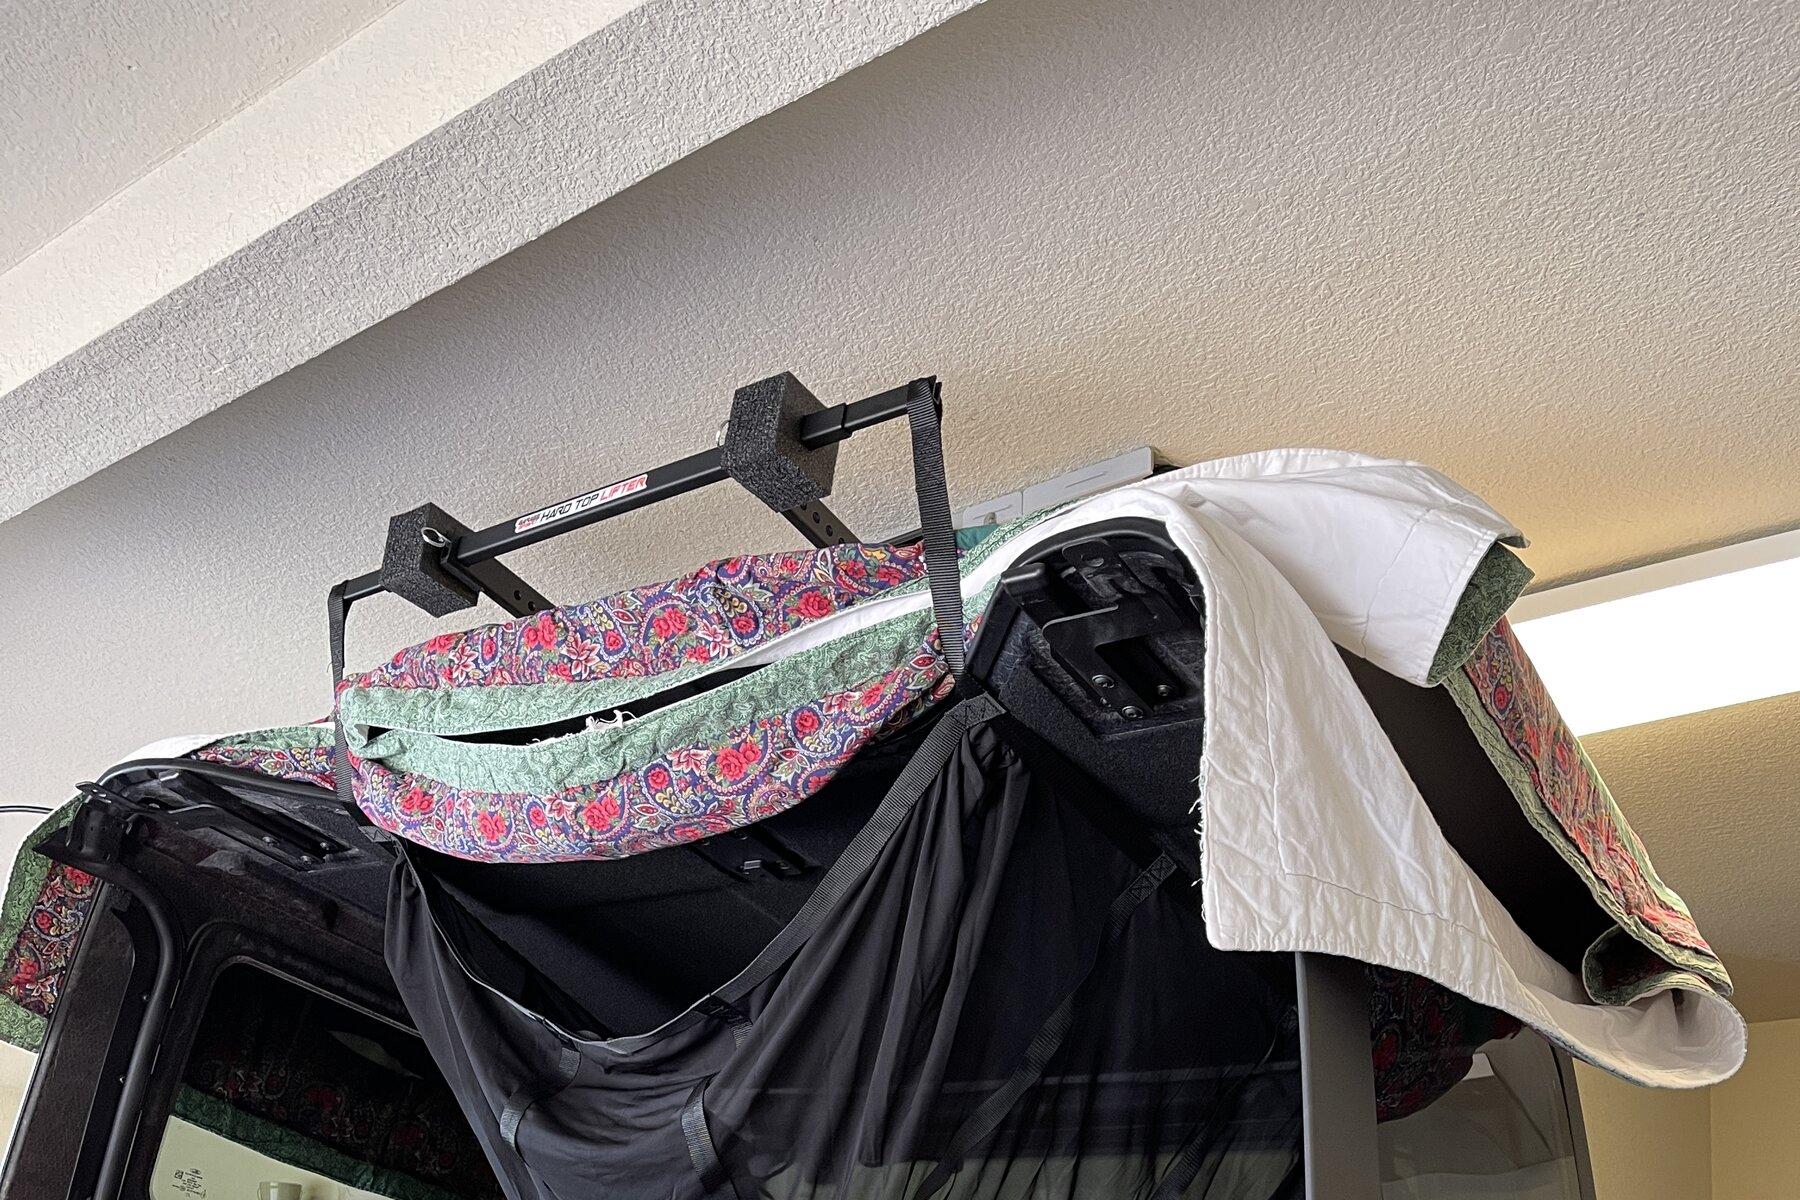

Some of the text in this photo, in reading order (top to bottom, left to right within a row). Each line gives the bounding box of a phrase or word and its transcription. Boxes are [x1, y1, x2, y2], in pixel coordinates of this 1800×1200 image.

[540, 477, 646, 521] HARD TOP LIFTER
